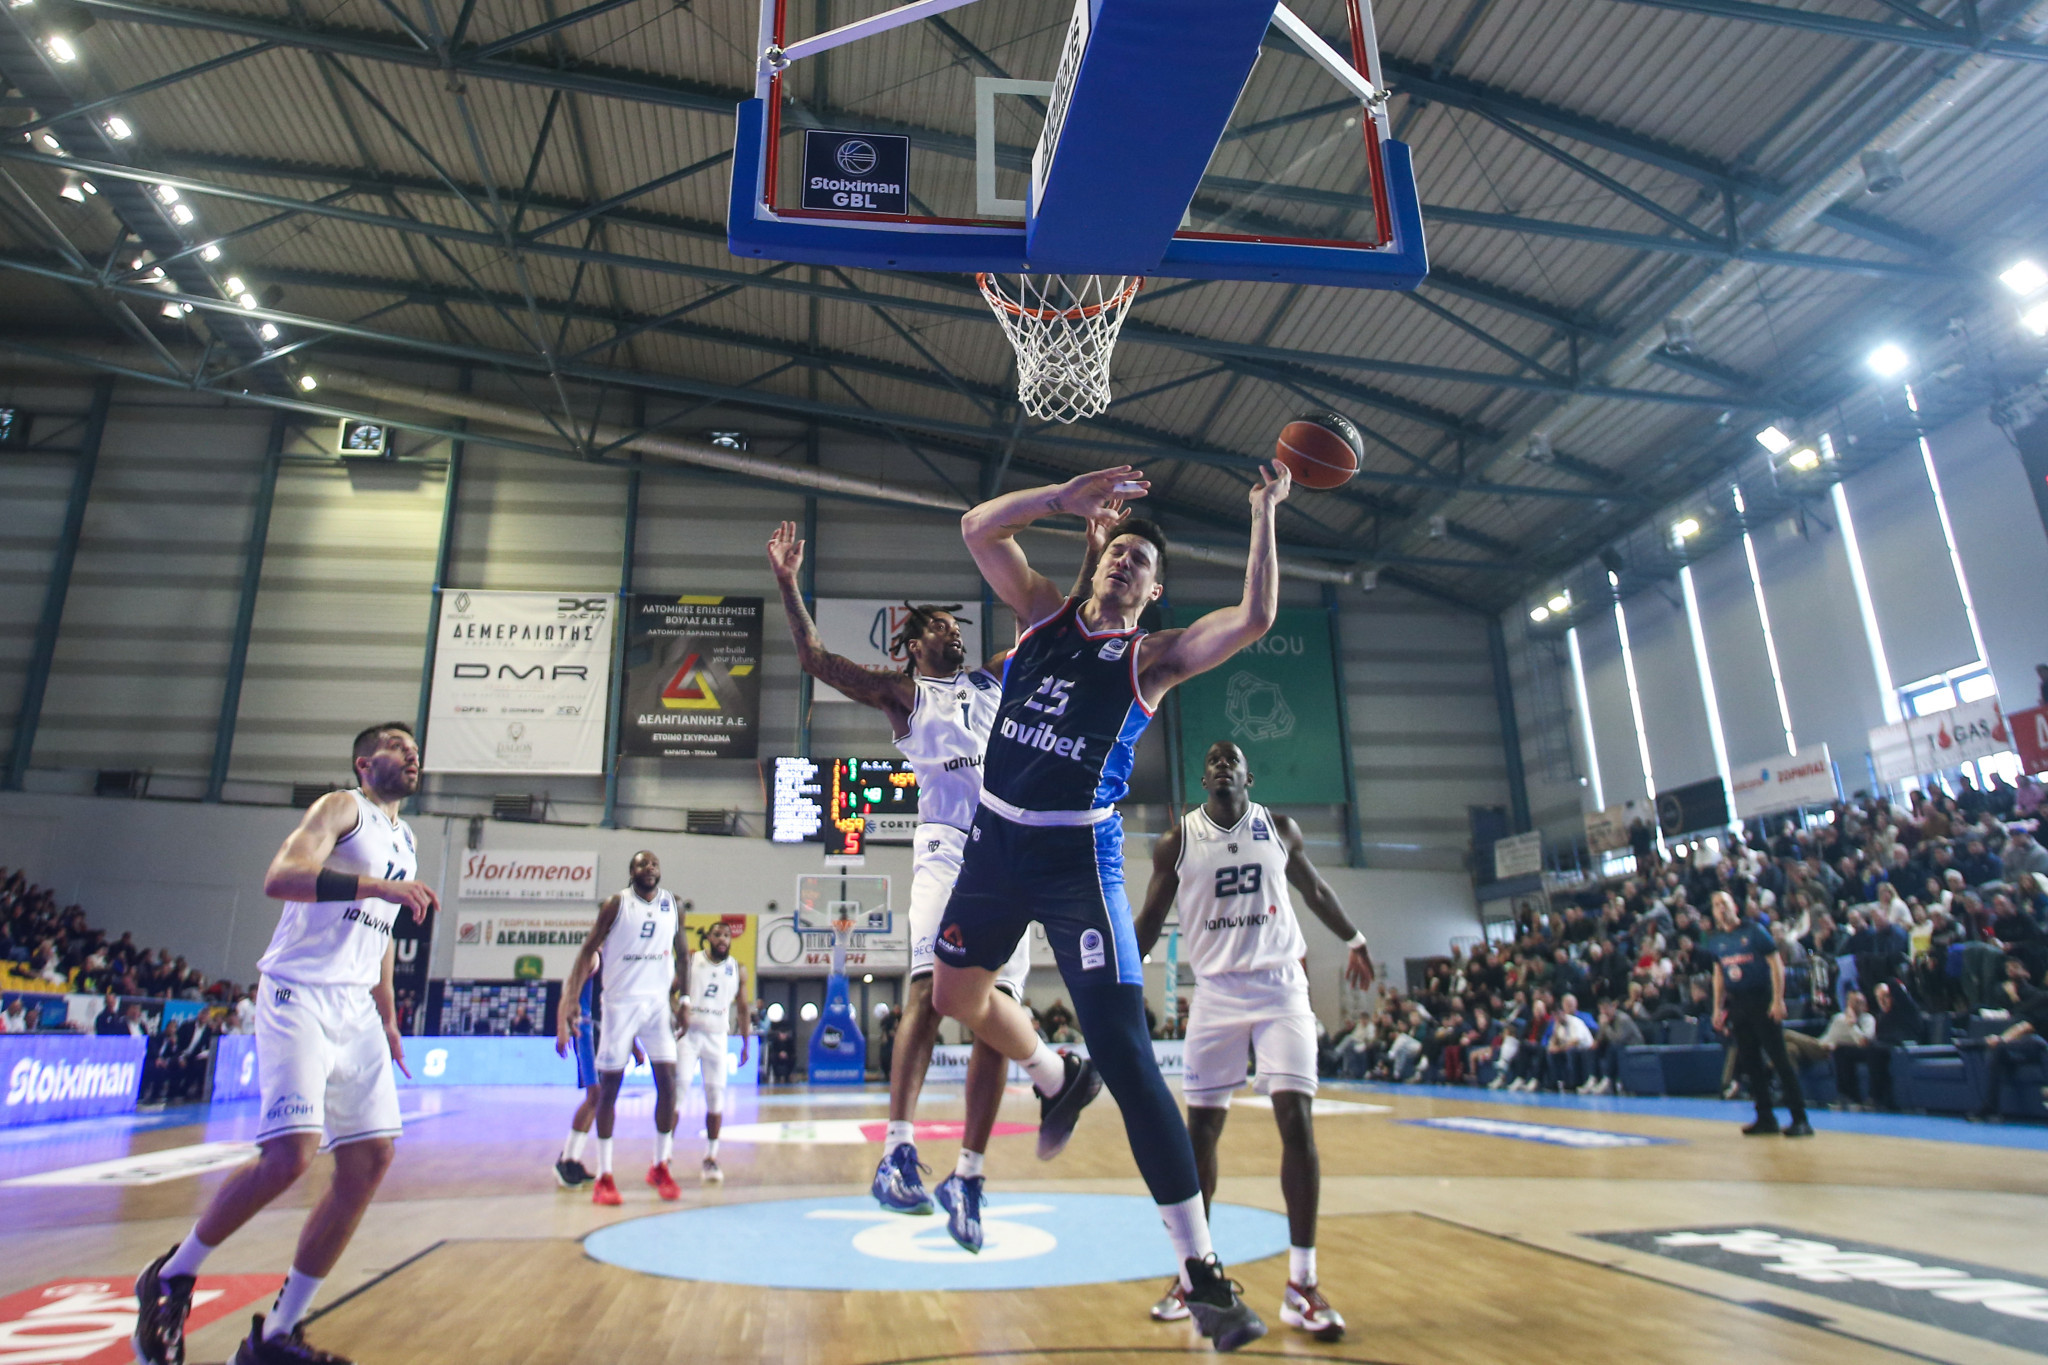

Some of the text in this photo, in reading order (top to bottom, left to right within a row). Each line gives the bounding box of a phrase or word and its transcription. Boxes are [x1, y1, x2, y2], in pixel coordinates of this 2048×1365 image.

[810, 176, 900, 195] Stoiximan
[832, 192, 877, 209] GBL
[642, 604, 756, 615] ΛΑΤΟΜΙΚΕΣ ΕΠΙΧΕΙΡΗΣΕΙΣ
[665, 615, 700, 625] ΒΟΥΛΑΣ
[453, 622, 594, 641] ΔΕΜΕΡΛΙΩΤΗΣ
[726, 646, 746, 654] build
[454, 663, 588, 680] DMR
[1024, 675, 1075, 716] 25
[638, 713, 723, 726] ΔΕΛΗΓΙΑΝΝΗΣ
[961, 703, 971, 731] 1
[653, 732, 731, 743] ΕΤΟΙΜΟ ΣΚΥΡΟΔΕΜΑ
[1953, 718, 1991, 743] GAS
[880, 820, 922, 828] CORTE
[843, 832, 862, 854] 5
[464, 854, 593, 882] Storismenos
[1215, 862, 1262, 898] 23
[640, 920, 657, 939] 9
[704, 983, 719, 998] 2
[8, 1056, 136, 1103] Stoiximan
